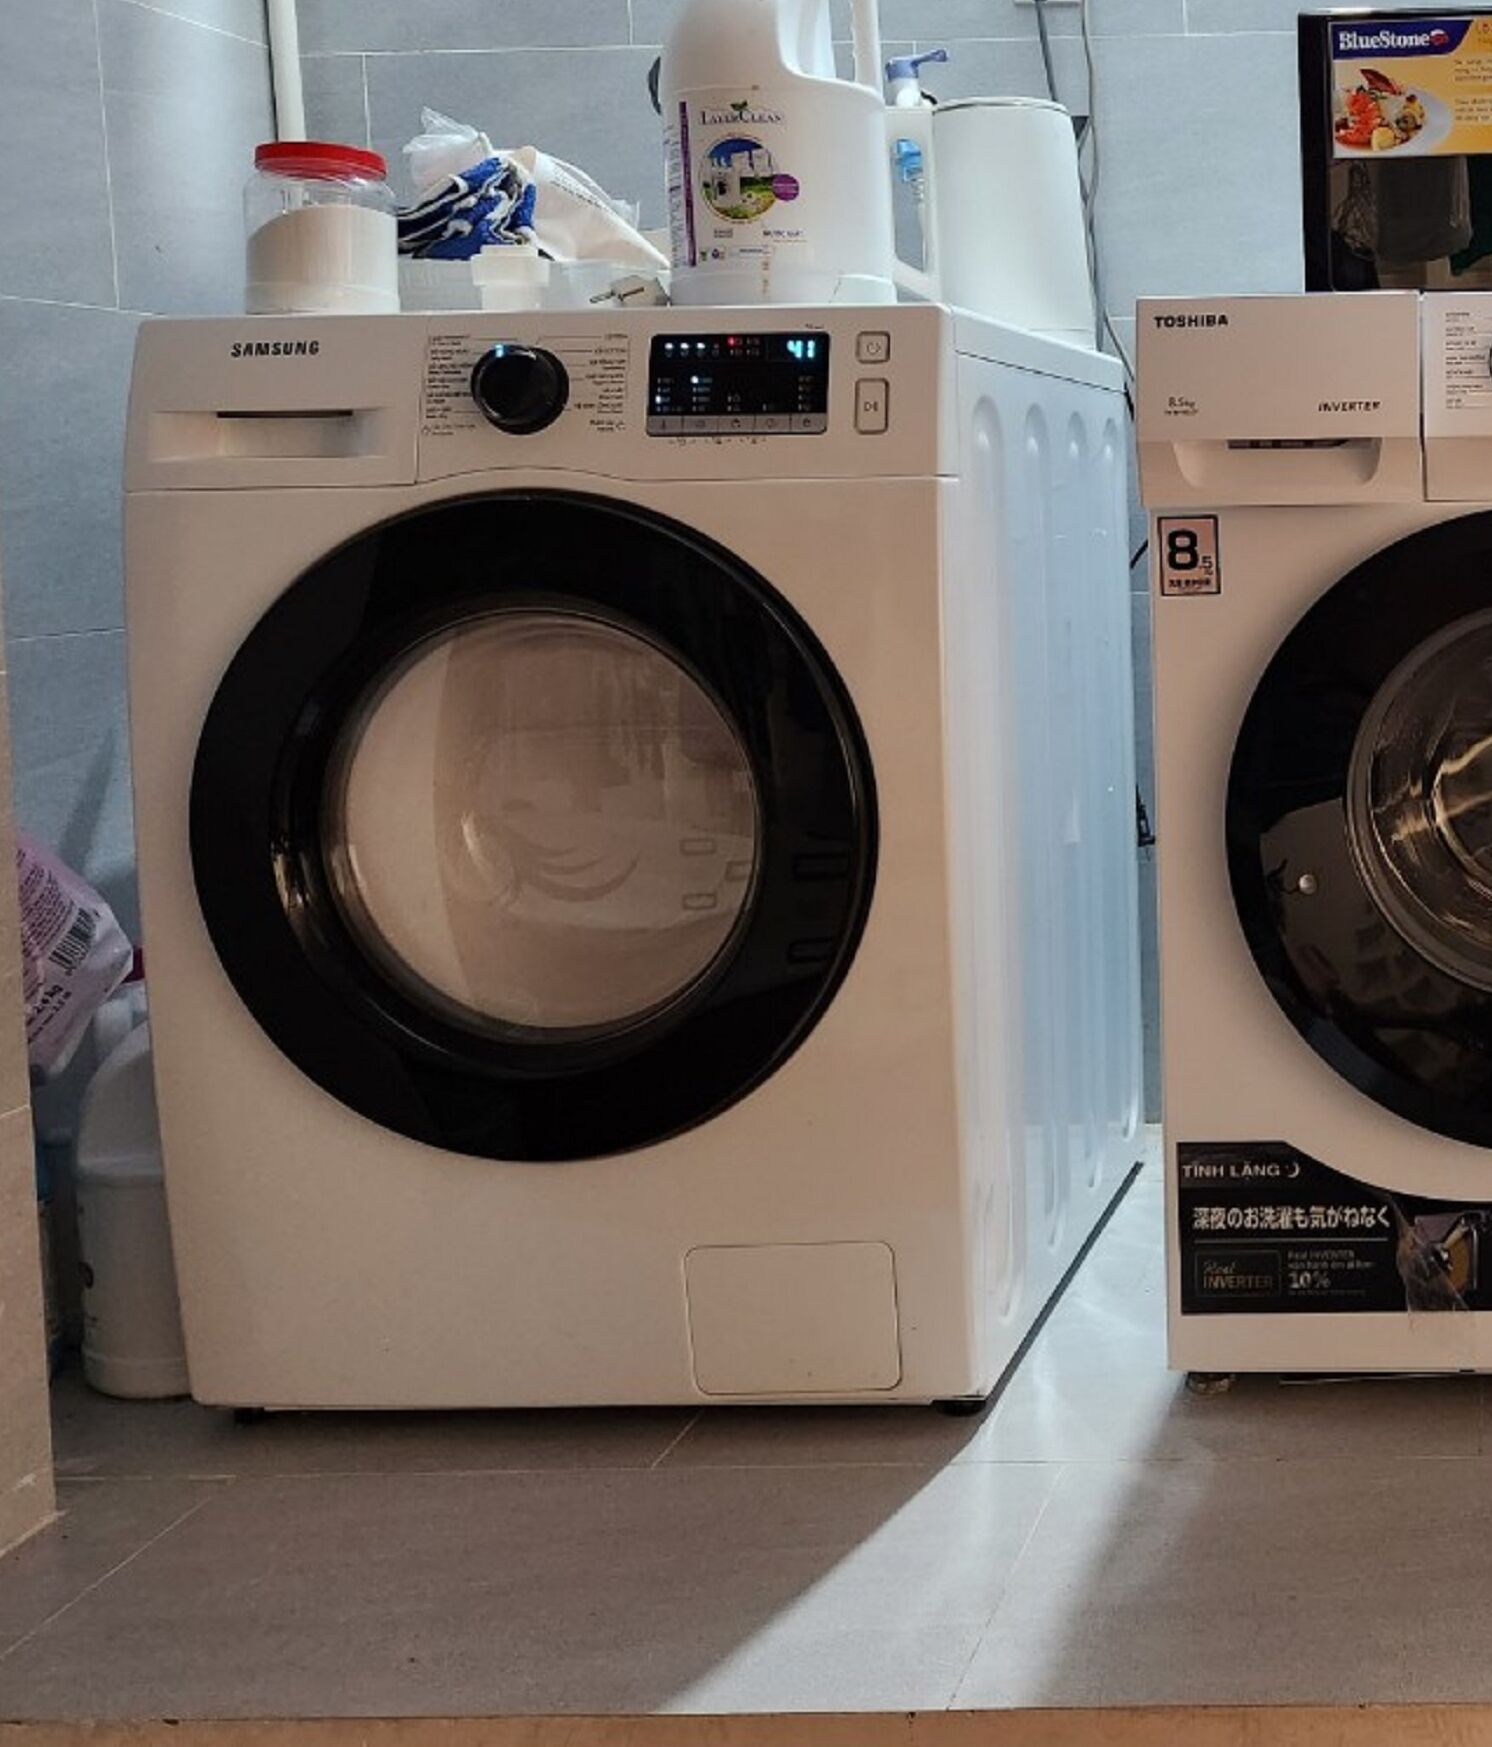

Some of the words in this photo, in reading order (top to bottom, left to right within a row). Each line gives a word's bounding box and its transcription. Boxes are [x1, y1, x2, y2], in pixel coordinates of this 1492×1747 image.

[1338, 29, 1430, 50] BlueStone
[1153, 314, 1229, 328] TOSHIBA
[230, 340, 320, 358] SAMSUNG
[1318, 401, 1381, 412] INVERTER
[1203, 1275, 1274, 1290] INVERTER
[1288, 1271, 1332, 1289] 10%
